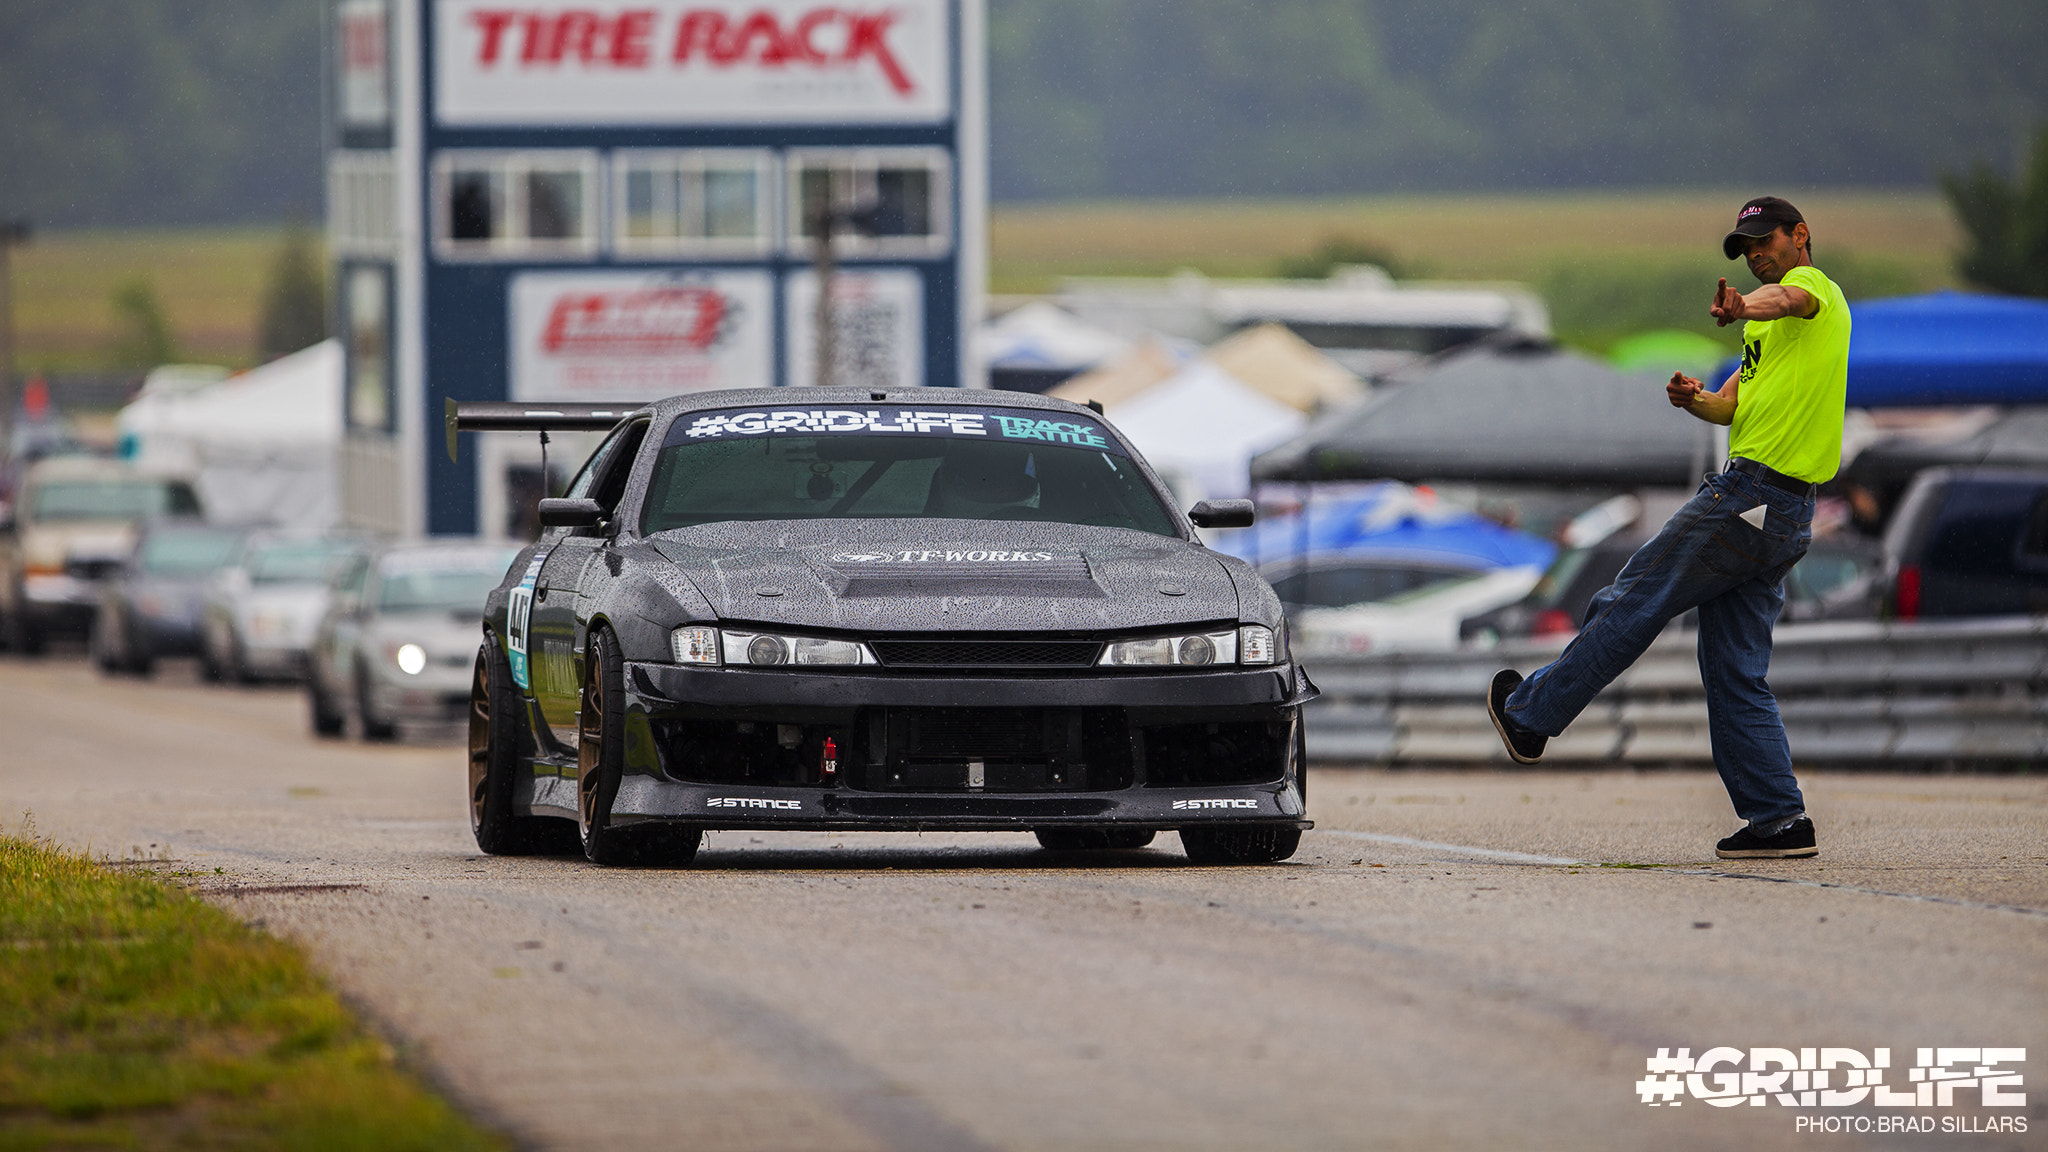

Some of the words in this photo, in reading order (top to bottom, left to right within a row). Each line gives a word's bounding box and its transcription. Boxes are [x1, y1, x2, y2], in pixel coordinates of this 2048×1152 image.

[469, 10, 659, 70] TIRE
[671, 8, 915, 95] RACK
[685, 410, 987, 438] #GRIDLIFE
[989, 415, 1094, 435] TRACK
[1002, 427, 1110, 449] BATTLE
[898, 550, 1052, 562] TF-WORKS
[722, 797, 802, 810] STANCE
[1188, 799, 1258, 809] STANCE
